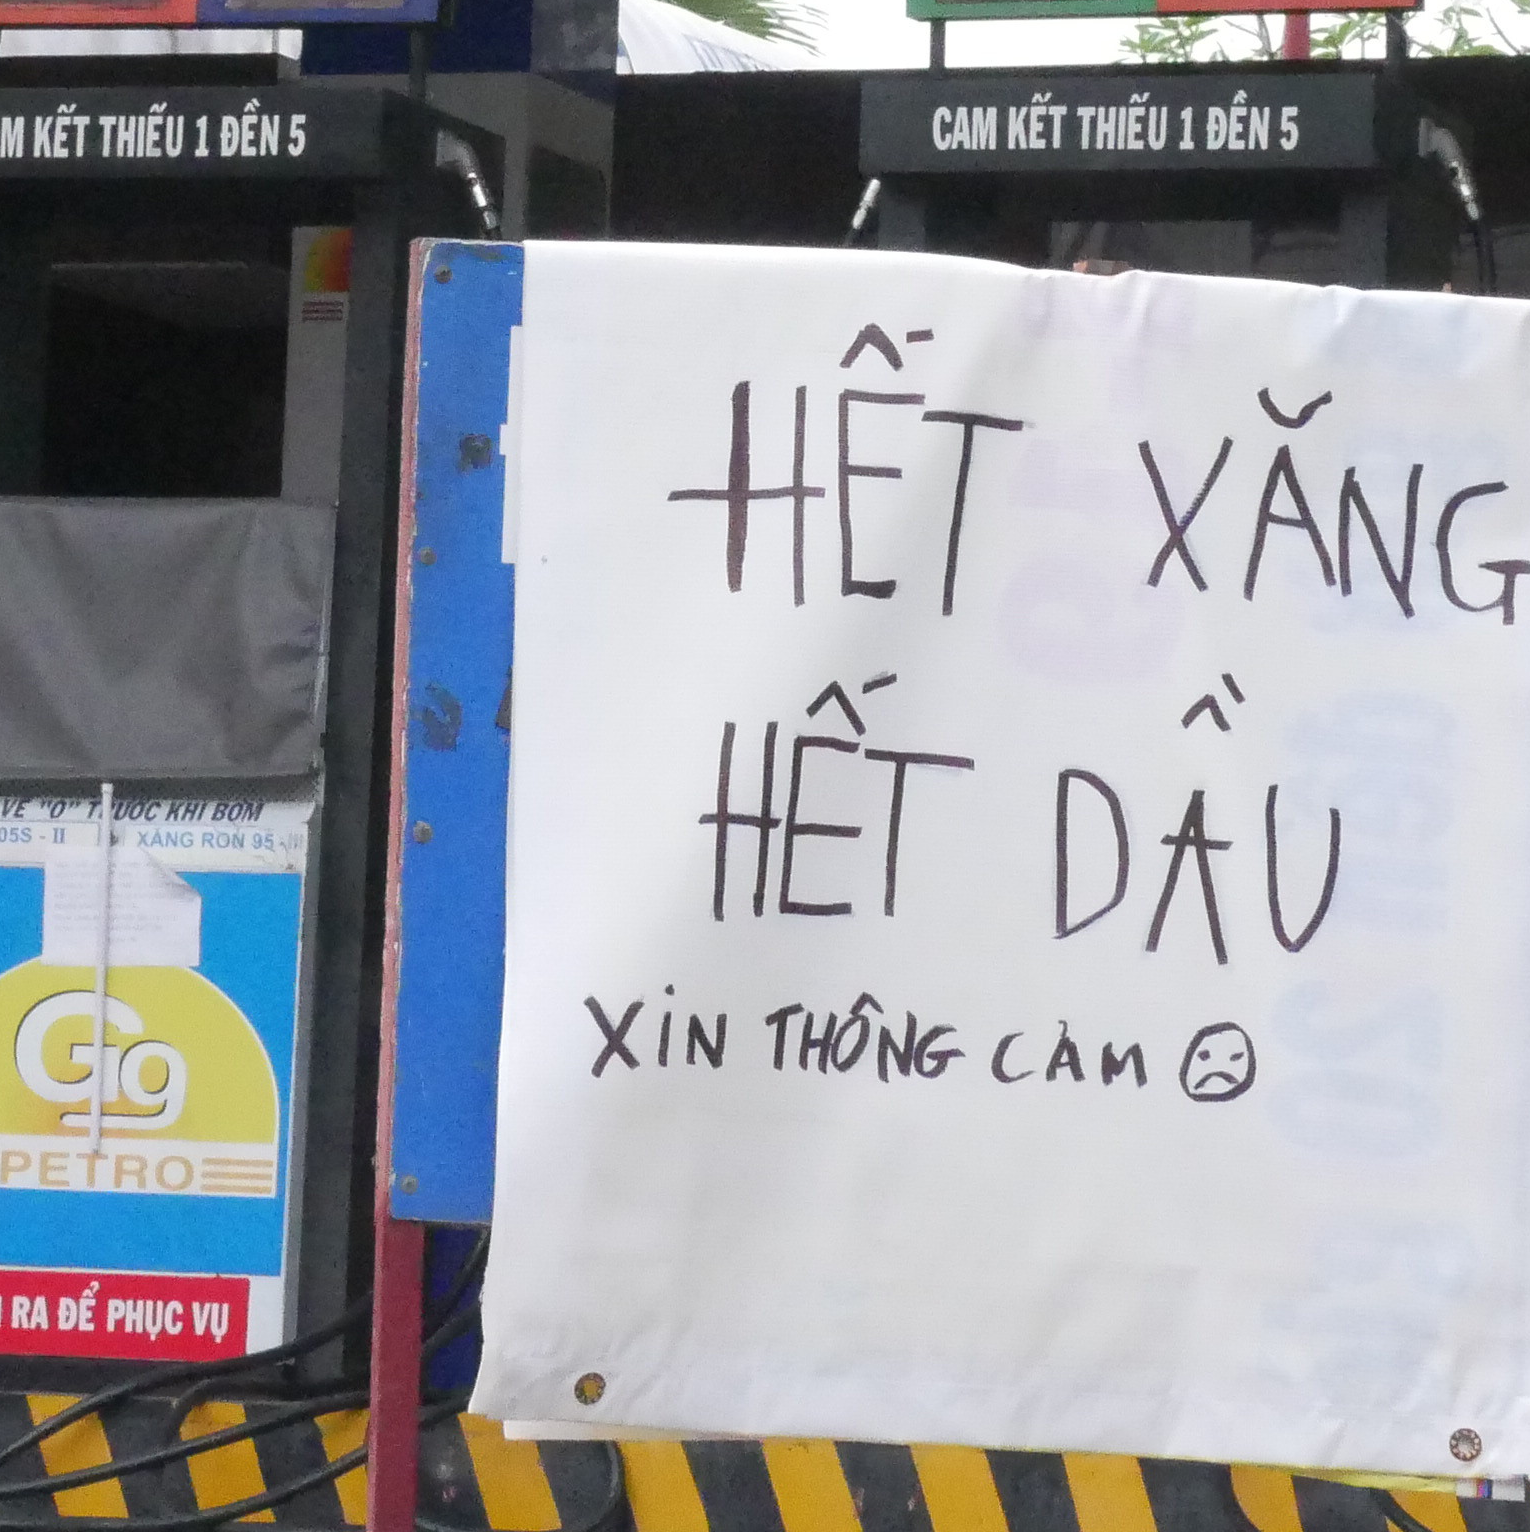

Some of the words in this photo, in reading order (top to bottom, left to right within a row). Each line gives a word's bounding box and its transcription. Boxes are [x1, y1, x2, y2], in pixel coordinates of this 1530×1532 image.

[34, 103, 89, 158] KẾT
[99, 100, 184, 157] THIẾU
[194, 117, 209, 157] 1
[288, 114, 306, 156] 5
[932, 105, 997, 151] CAM
[1008, 92, 1067, 150] KẾT
[1076, 92, 1168, 150] THIẾU
[1180, 106, 1194, 150] 1
[1280, 105, 1299, 150] 5
[669, 324, 1036, 615] HẾT
[166, 800, 207, 821] KHI
[202, 831, 244, 849] RON
[252, 831, 275, 849] 95
[699, 674, 973, 920] HẾT
[1052, 674, 1339, 963] DẦU
[765, 991, 965, 1084] THÔNG
[992, 1019, 1147, 1087] CẢM
[0, 1150, 195, 1192] PETRO
[11, 1296, 49, 1330] RA
[59, 1280, 102, 1332] ĐỂ
[107, 1298, 183, 1340] PHỤC
[193, 1302, 229, 1343] VỤ
